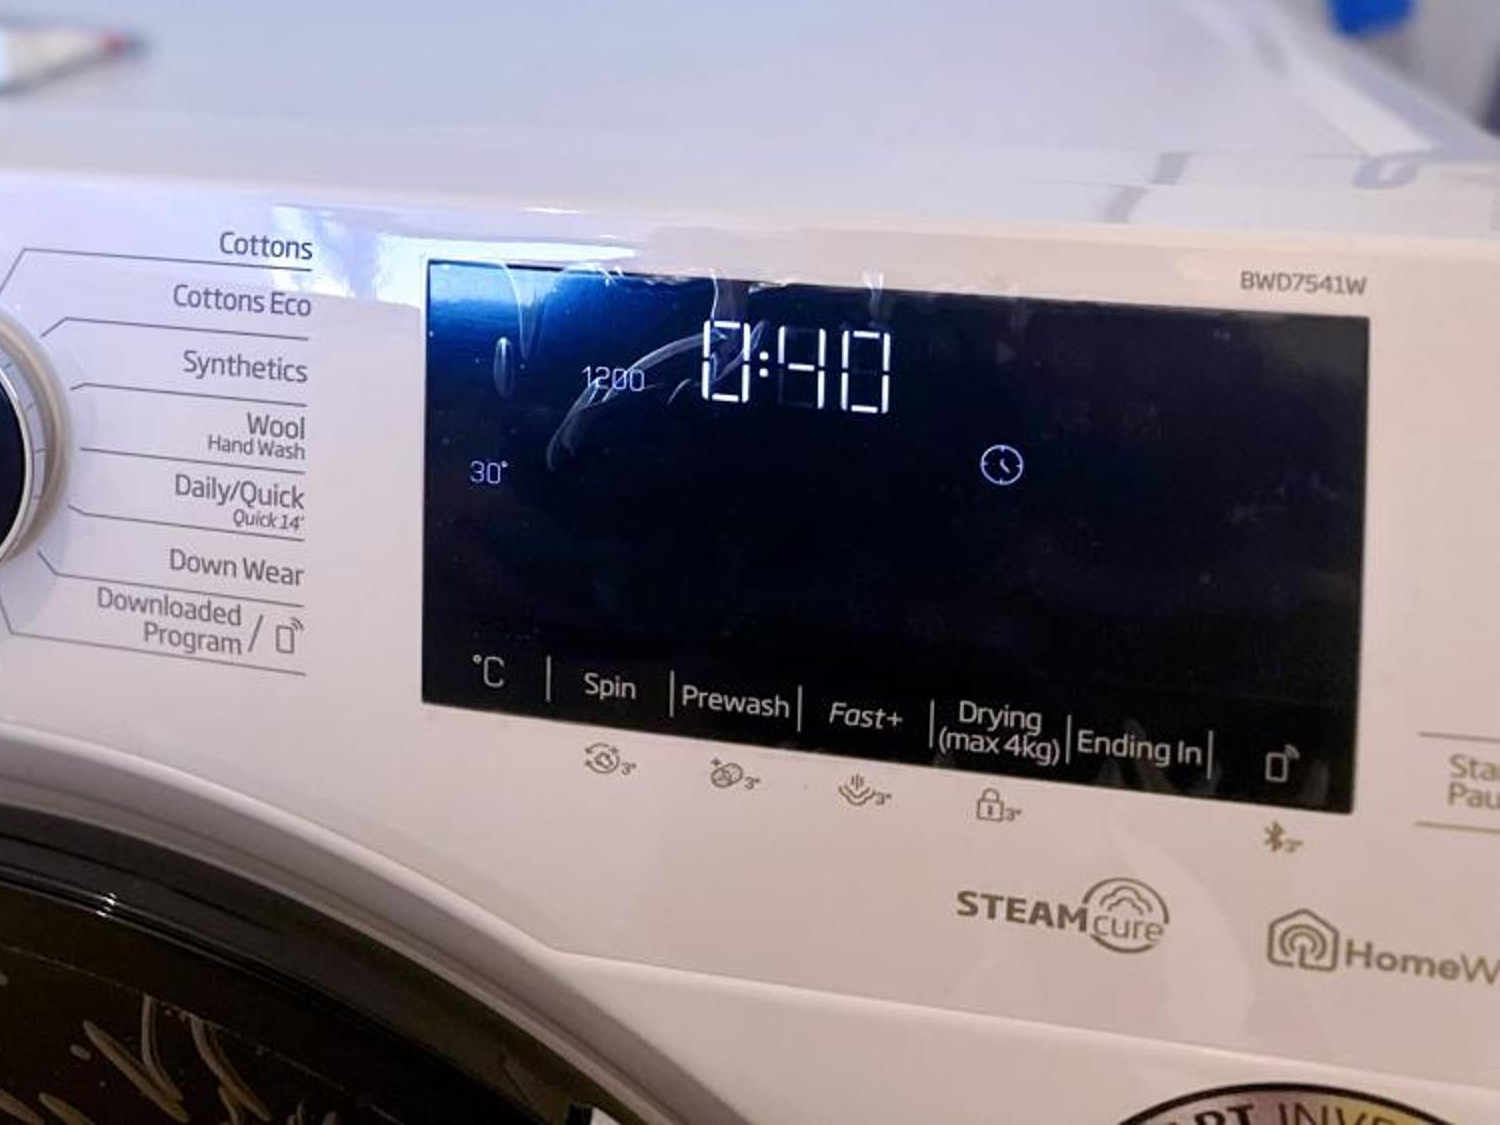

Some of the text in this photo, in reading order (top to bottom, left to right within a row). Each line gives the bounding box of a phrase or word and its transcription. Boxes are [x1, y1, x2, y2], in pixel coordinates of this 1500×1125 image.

[219, 231, 313, 261] Cottons
[1240, 271, 1368, 295] BWD7541W
[173, 284, 312, 317] Cottons Eco
[183, 349, 308, 383] Synthetics
[581, 364, 646, 393] 1200
[702, 318, 892, 415] 0:40
[247, 411, 305, 440] Wool
[207, 434, 305, 460] Hand Wash
[174, 473, 305, 509] Daily/Quick
[233, 508, 278, 528] Quick
[169, 548, 304, 586] Down Wear
[97, 586, 242, 626] Downloaded
[143, 621, 242, 655] Program
[584, 672, 637, 700] Spin
[682, 684, 790, 718] Prewash
[829, 701, 903, 730] Fast+
[959, 700, 1043, 736] Drying
[939, 727, 1060, 766] (max 4kg)
[1077, 730, 1202, 768] Ending In
[956, 890, 1088, 933] STEAM
